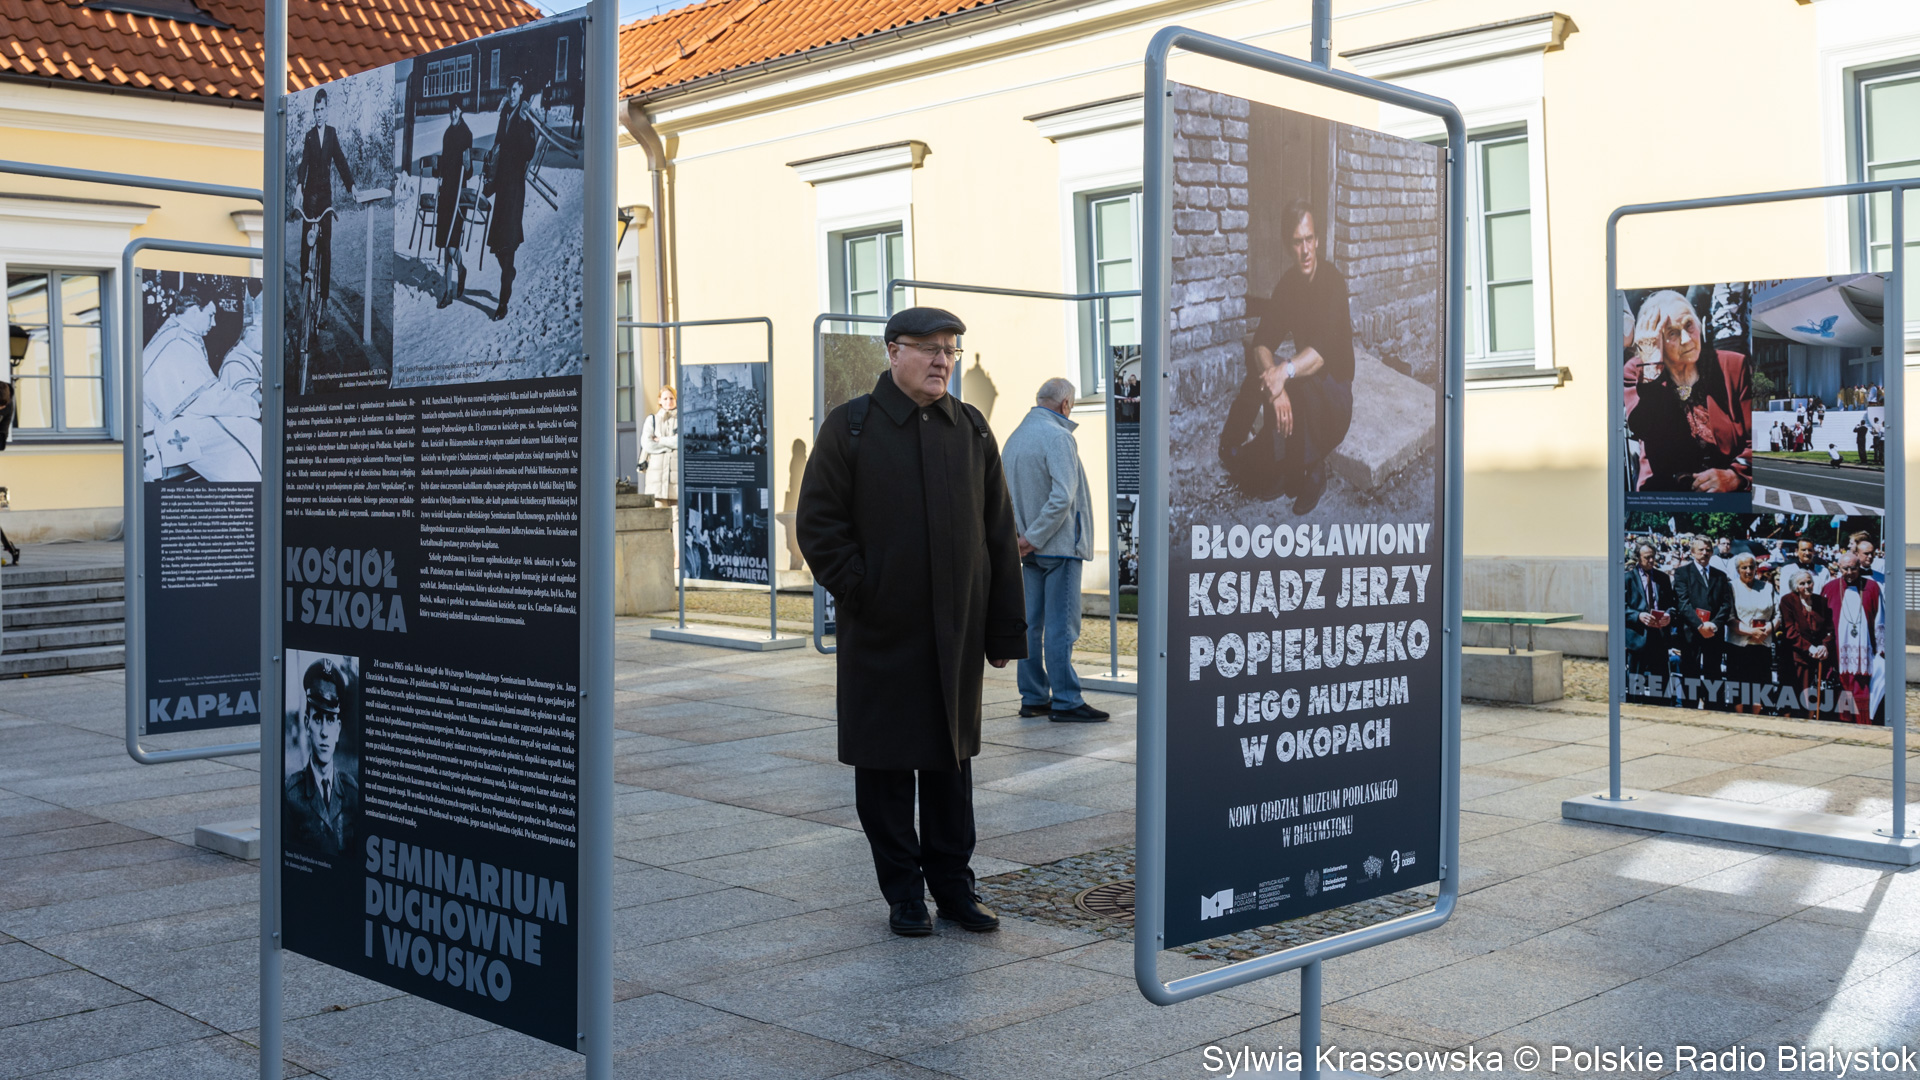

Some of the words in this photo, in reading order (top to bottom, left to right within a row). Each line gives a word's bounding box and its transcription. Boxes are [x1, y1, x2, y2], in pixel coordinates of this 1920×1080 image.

[1192, 523, 1430, 559] BŁOGOSŁAWIONY
[286, 546, 397, 588] KOŚCIÓŁ
[286, 587, 293, 622] I
[301, 588, 407, 633] SZKOŁA
[1189, 569, 1326, 619] KSIĄDZ
[1336, 565, 1431, 608] JERZY
[1189, 619, 1429, 681] POPIEŁUSZKO
[149, 690, 260, 723] KAPŁA
[1217, 696, 1224, 727] I
[1233, 688, 1300, 725] JEGO
[1308, 675, 1409, 716] MUZEUM
[1629, 673, 1860, 715] BEATYFIKACJA
[1240, 734, 1268, 768] W
[1276, 718, 1390, 762] OKOPACH
[1229, 804, 1258, 828] NOWY
[1261, 797, 1300, 822] ODDZIAŁ
[1303, 789, 1340, 815] MUZEUM
[1343, 779, 1398, 807] PODLASKIEGO
[1282, 827, 1291, 847] W
[1294, 814, 1353, 845] BIAŁYMSTOKU
[366, 835, 568, 925] SEMINARIUM
[366, 876, 541, 966] DUCHOWNE
[365, 920, 373, 958] I
[382, 924, 512, 1002] WOJSKO
